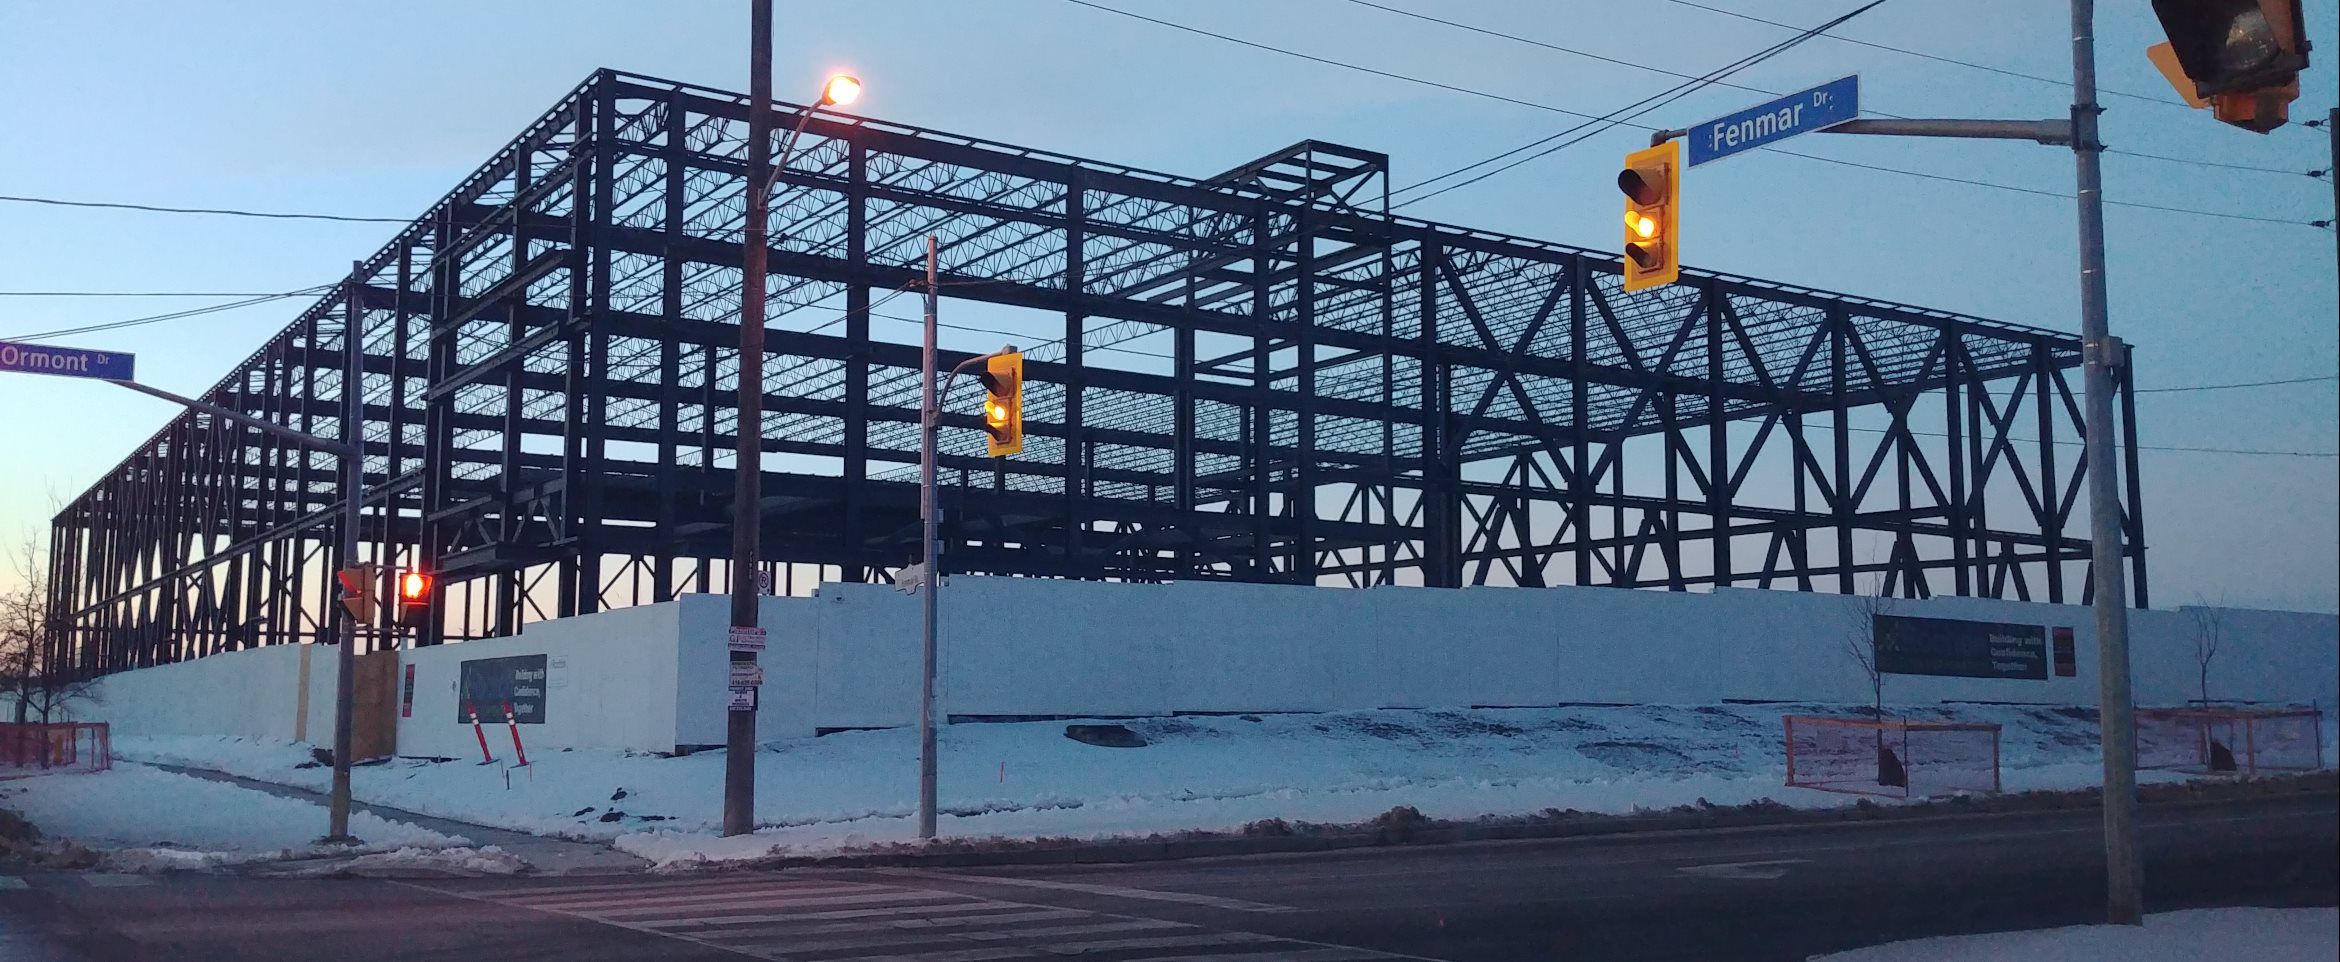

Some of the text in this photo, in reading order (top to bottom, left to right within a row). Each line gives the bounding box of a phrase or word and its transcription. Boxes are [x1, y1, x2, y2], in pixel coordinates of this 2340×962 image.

[1714, 91, 1828, 151] Fenmar Dr
[1, 346, 110, 371] Ormont Dr
[1989, 634, 2043, 646] Building with
